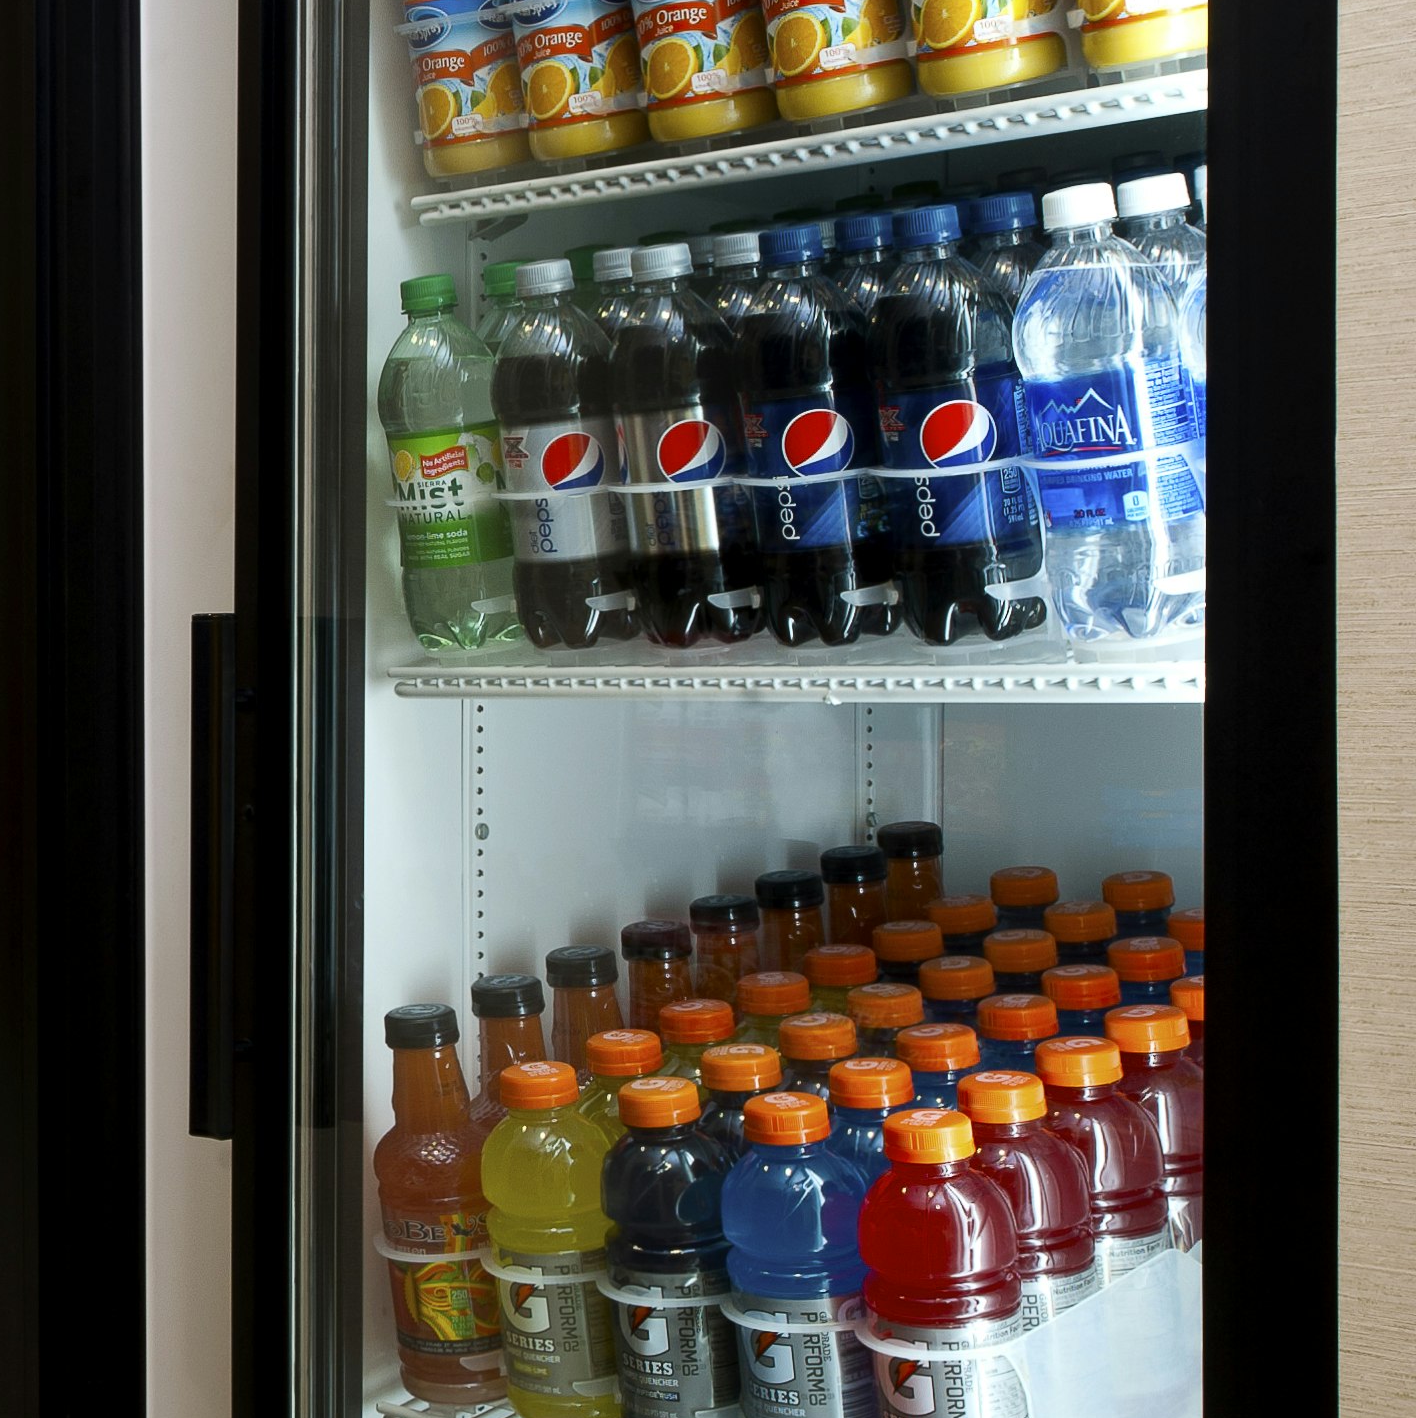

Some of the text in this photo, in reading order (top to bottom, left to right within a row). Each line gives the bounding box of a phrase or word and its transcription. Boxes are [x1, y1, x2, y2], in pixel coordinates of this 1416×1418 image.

[656, 7, 708, 25] Orange
[534, 30, 583, 49] Orange
[422, 53, 466, 73] Orange
[434, 450, 465, 465] Artificial
[423, 460, 465, 476] Ingredients
[1003, 467, 1019, 481] 250
[1103, 467, 1134, 480] WATER
[417, 480, 447, 488] SIERRA
[915, 477, 940, 537] peps
[446, 527, 468, 538] soda
[535, 498, 558, 554] peps
[1110, 1247, 1146, 1258] Nutrition
[1053, 1283, 1083, 1295] Nutrition
[554, 1265, 581, 1341] PRFORM
[675, 1285, 700, 1365] PRFORM
[800, 1312, 828, 1394] PRFORM
[622, 1352, 675, 1376] SERIES
